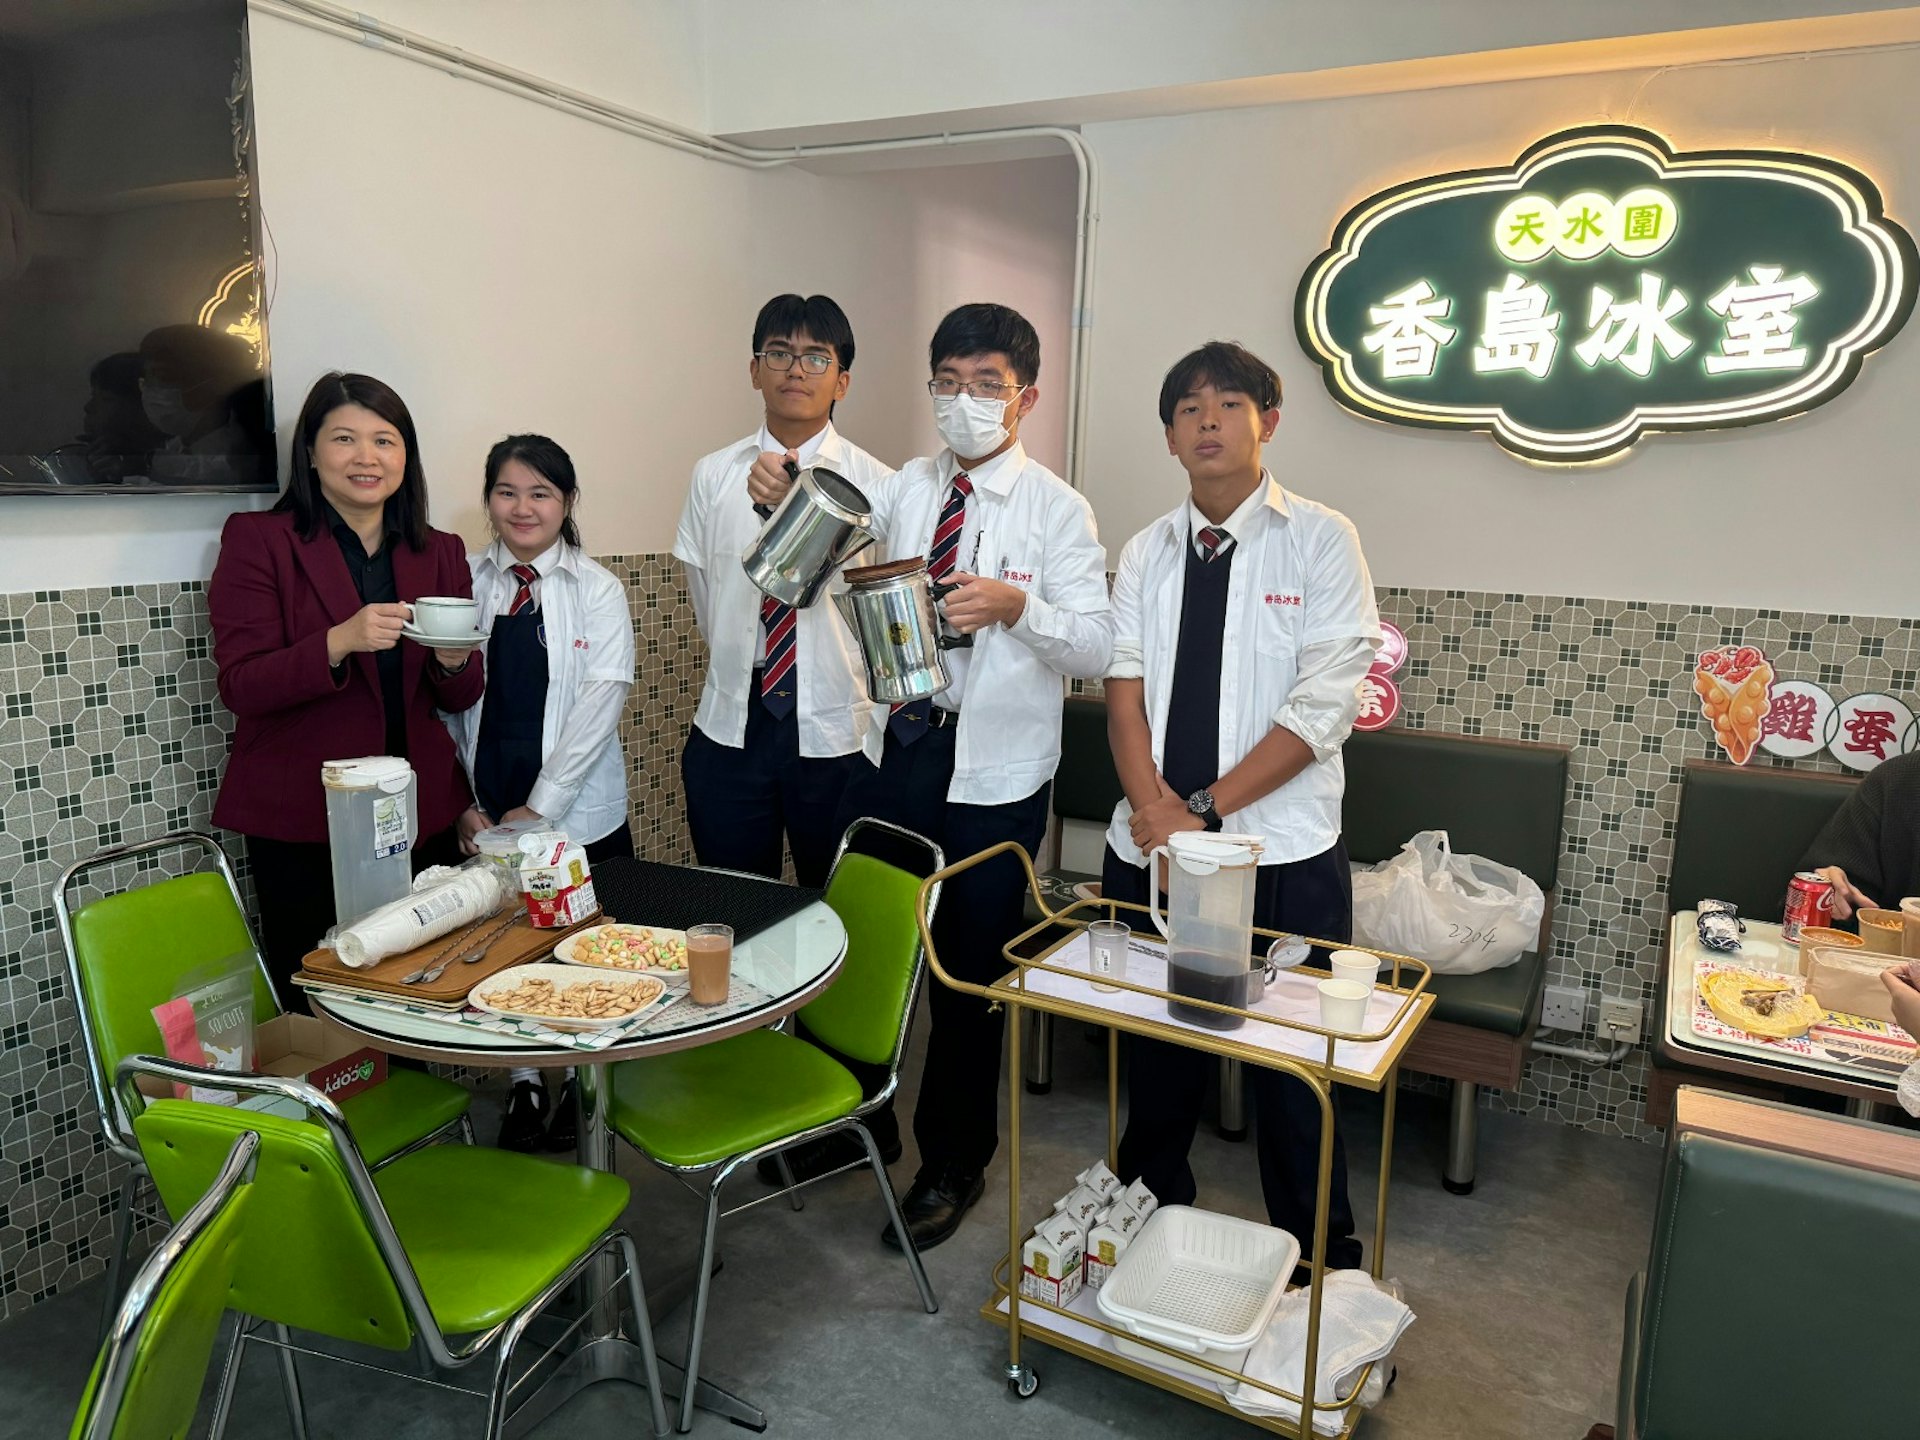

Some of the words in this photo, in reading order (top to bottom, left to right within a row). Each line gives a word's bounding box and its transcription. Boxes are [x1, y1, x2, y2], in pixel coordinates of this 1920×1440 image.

[1508, 201, 1663, 245] 天水圍
[1363, 265, 1820, 380] 香島冰室
[1448, 923, 1497, 951] 2204
[324, 1068, 360, 1095] COPY
